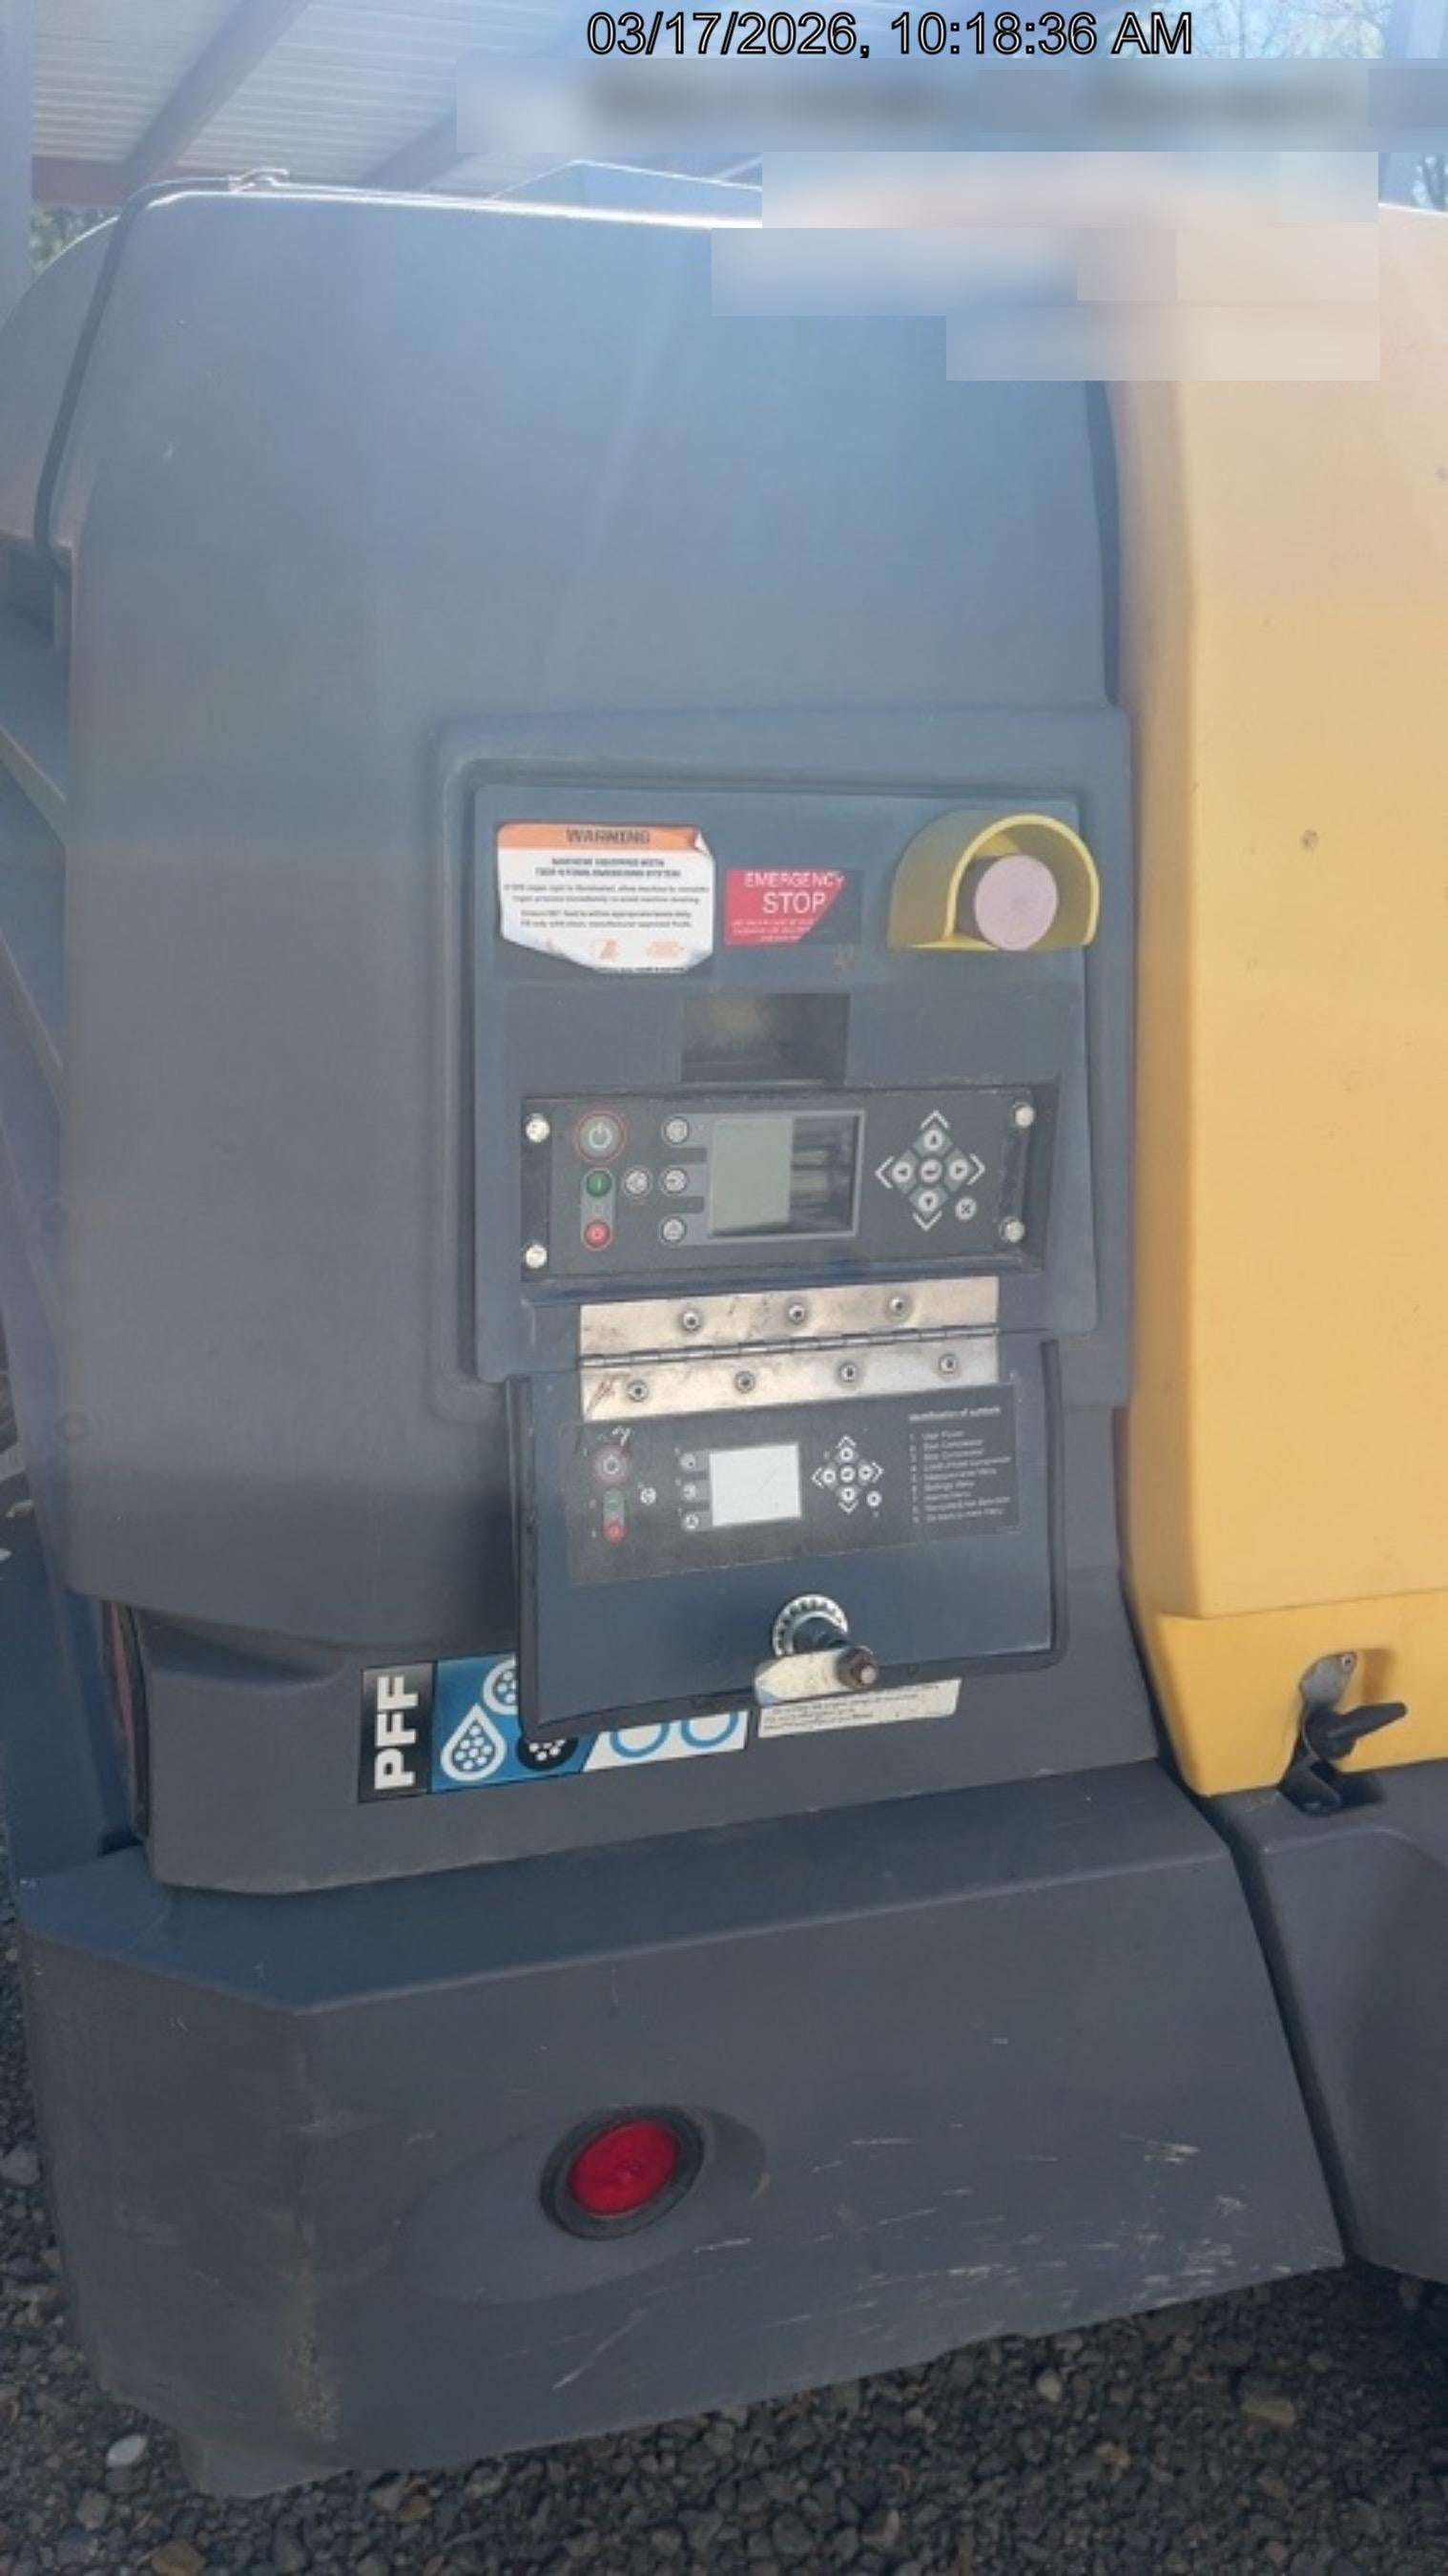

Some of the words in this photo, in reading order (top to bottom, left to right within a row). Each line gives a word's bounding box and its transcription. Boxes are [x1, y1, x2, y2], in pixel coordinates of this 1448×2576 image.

[566, 828, 652, 845] WARNING
[763, 891, 826, 914] STOP
[374, 1675, 419, 1790] PFF
